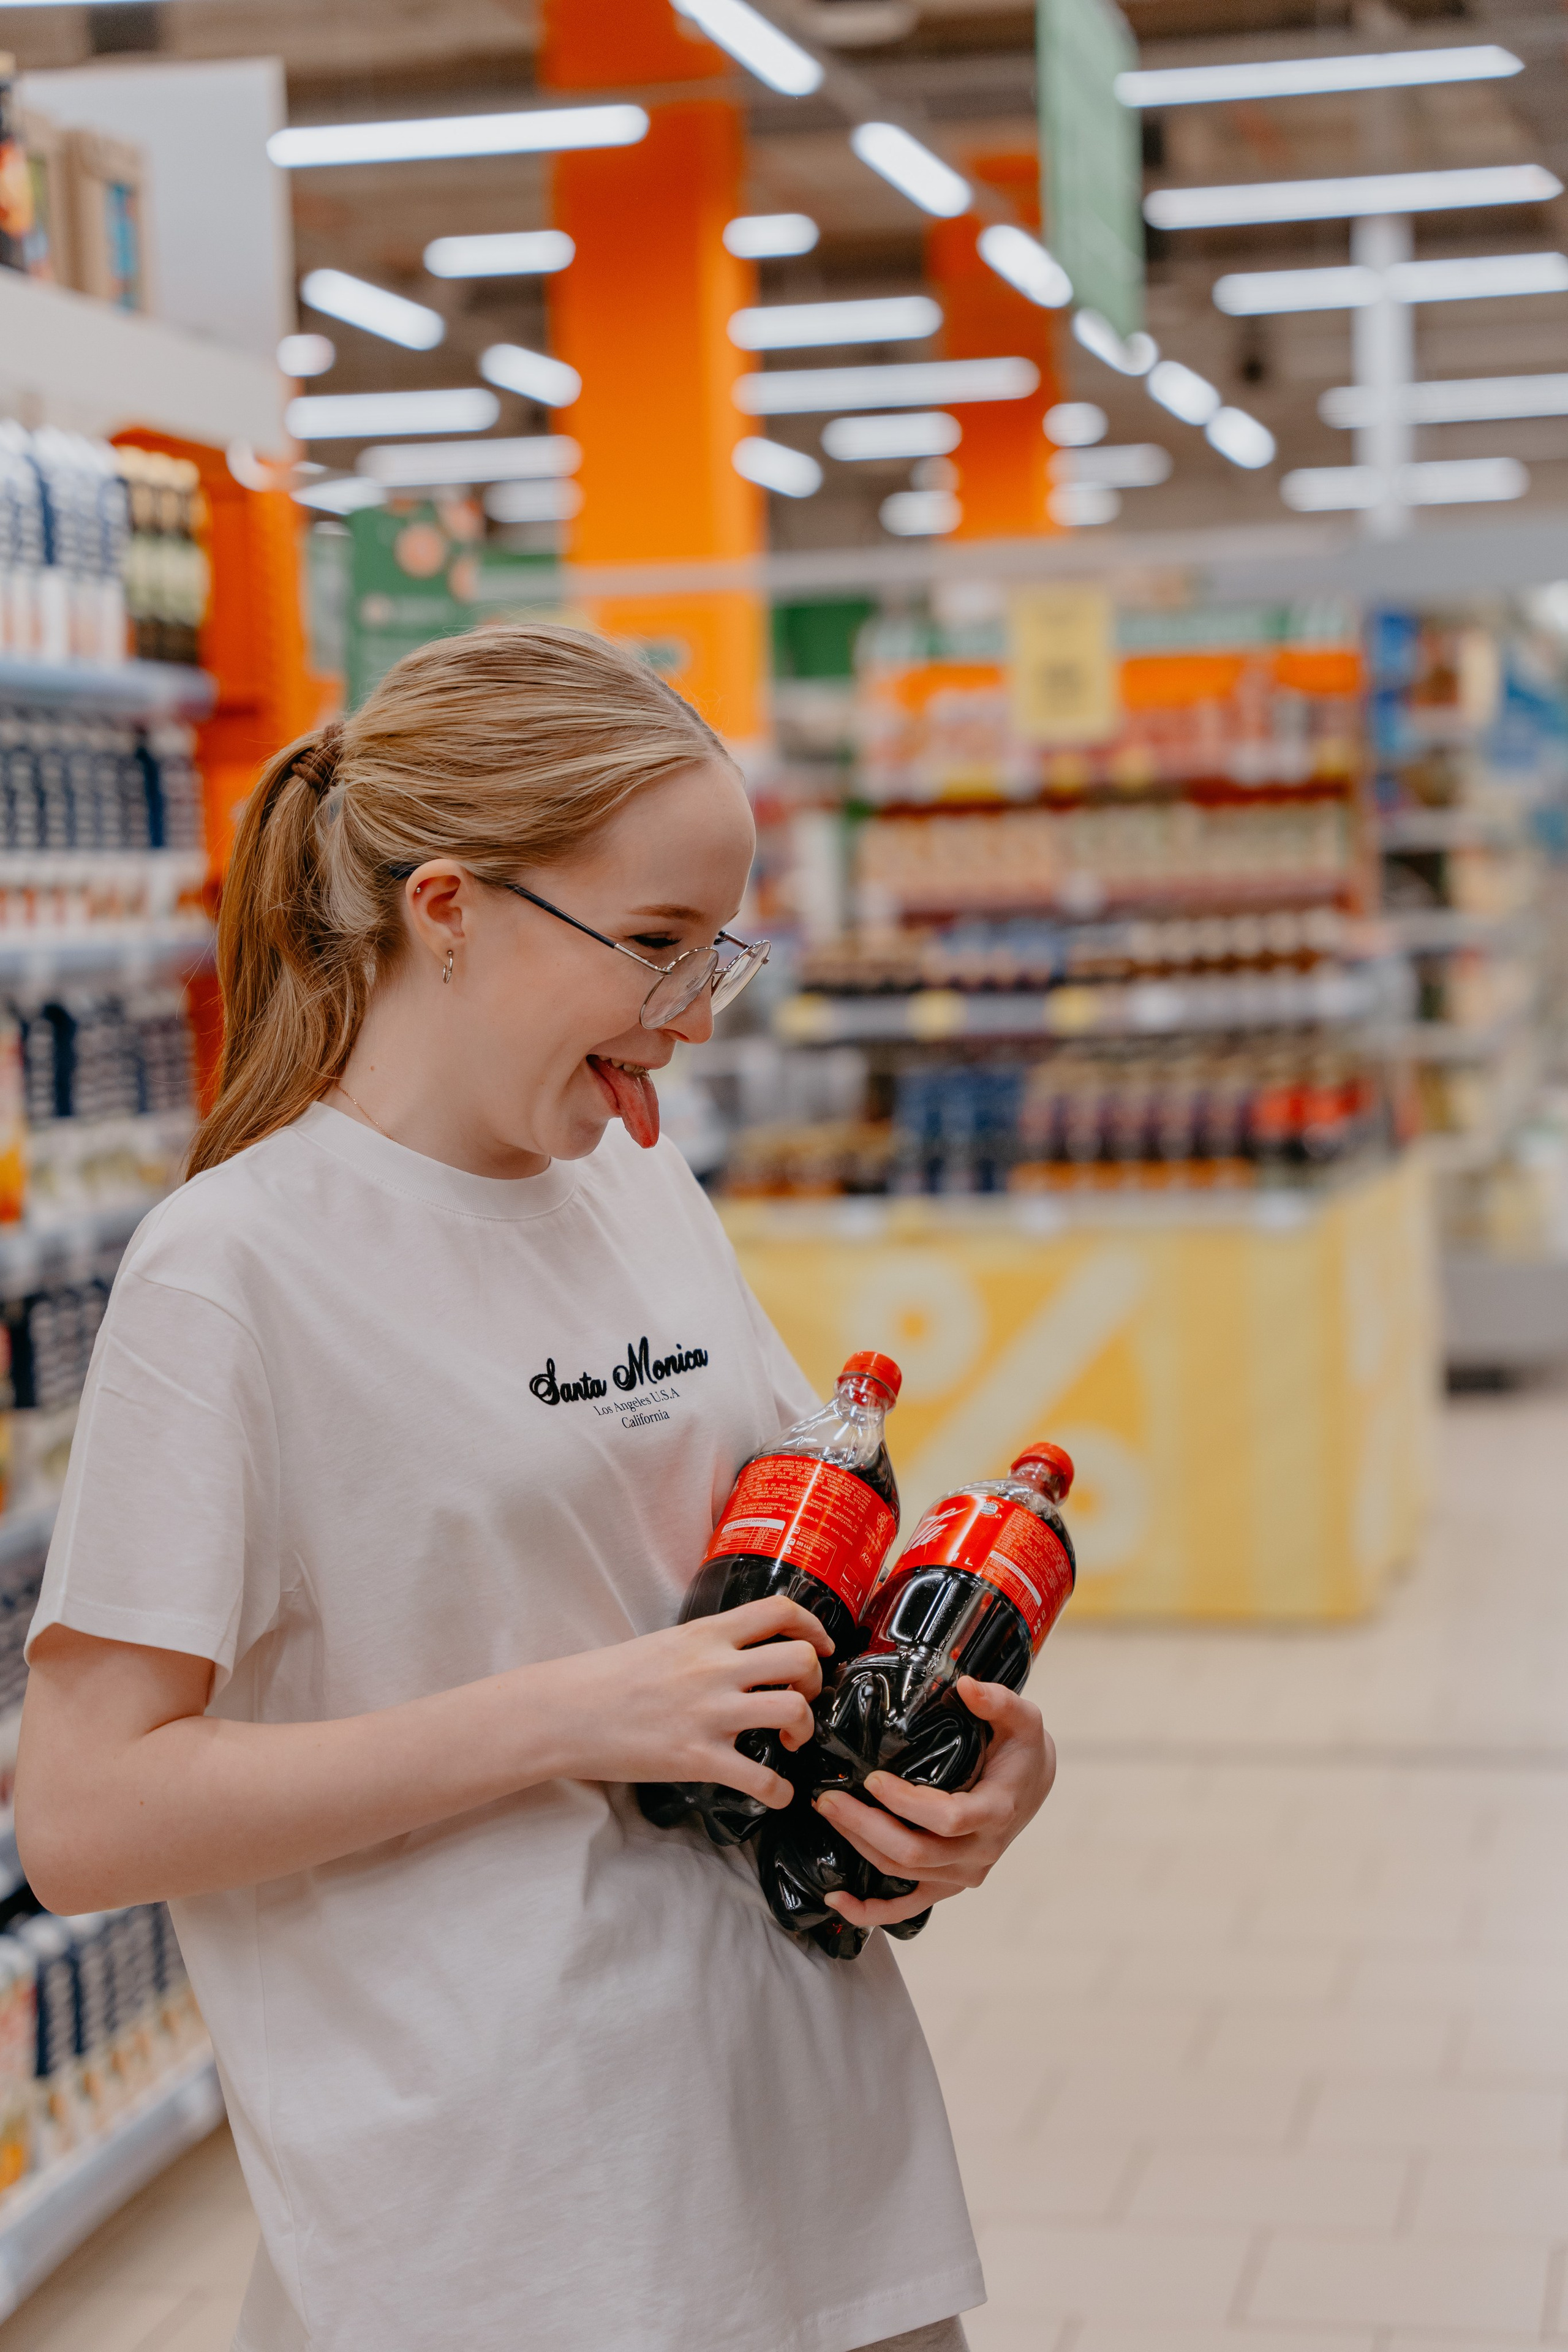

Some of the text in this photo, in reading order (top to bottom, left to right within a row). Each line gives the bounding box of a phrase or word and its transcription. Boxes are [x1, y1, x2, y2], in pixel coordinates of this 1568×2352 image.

[529, 1336, 709, 1406] Santa Monica
[593, 1387, 680, 1416] Los Angeles U.S.A
[621, 1409, 670, 1429] California
[805, 1501, 823, 1511] URŞUSU),
[965, 1557, 973, 1566] L
